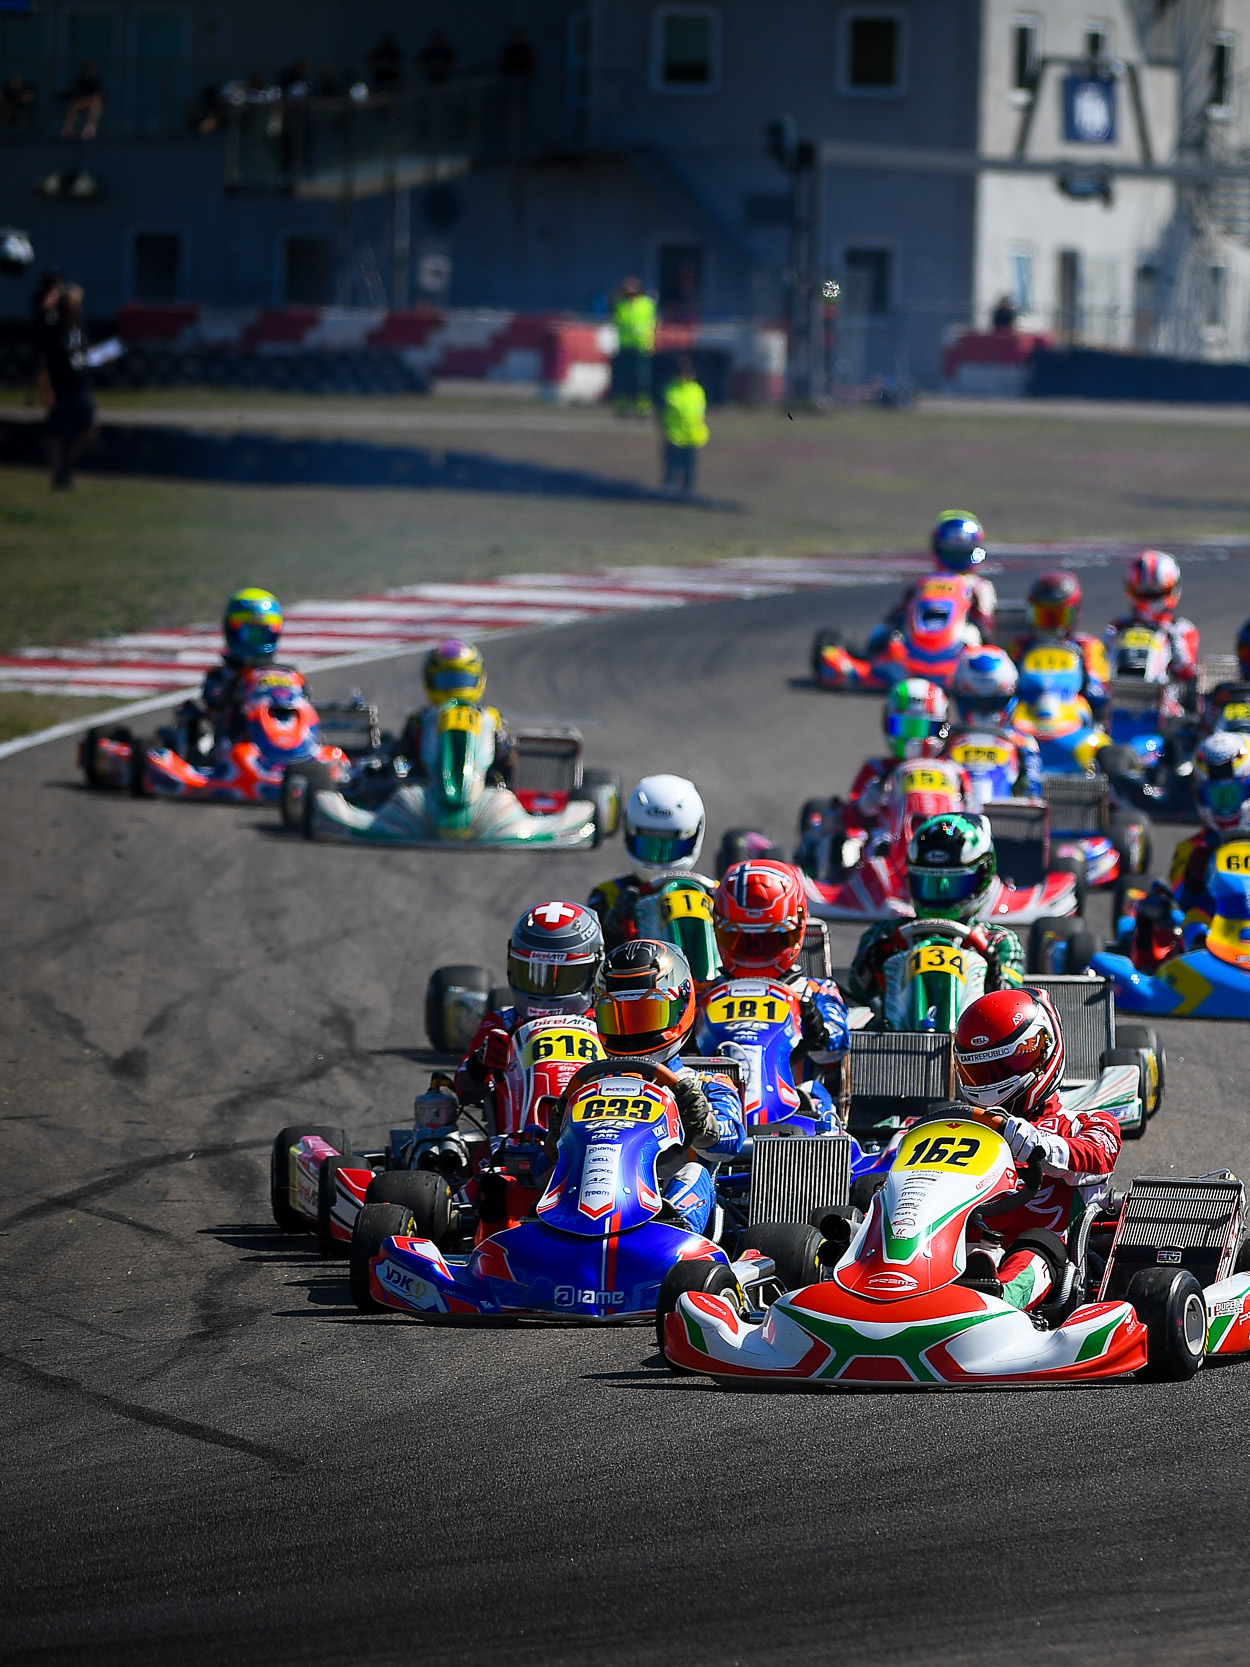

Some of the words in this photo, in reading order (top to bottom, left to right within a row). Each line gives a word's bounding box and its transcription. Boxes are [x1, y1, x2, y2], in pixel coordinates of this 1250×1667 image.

[909, 948, 965, 975] 134
[722, 1000, 777, 1020] 181
[532, 1035, 599, 1061] 618
[961, 1047, 1010, 1063] KARTREPUBLIC
[582, 1098, 653, 1120] 633
[591, 1132, 620, 1141] KART
[903, 1136, 981, 1168] 162
[868, 1278, 918, 1288] PREMA
